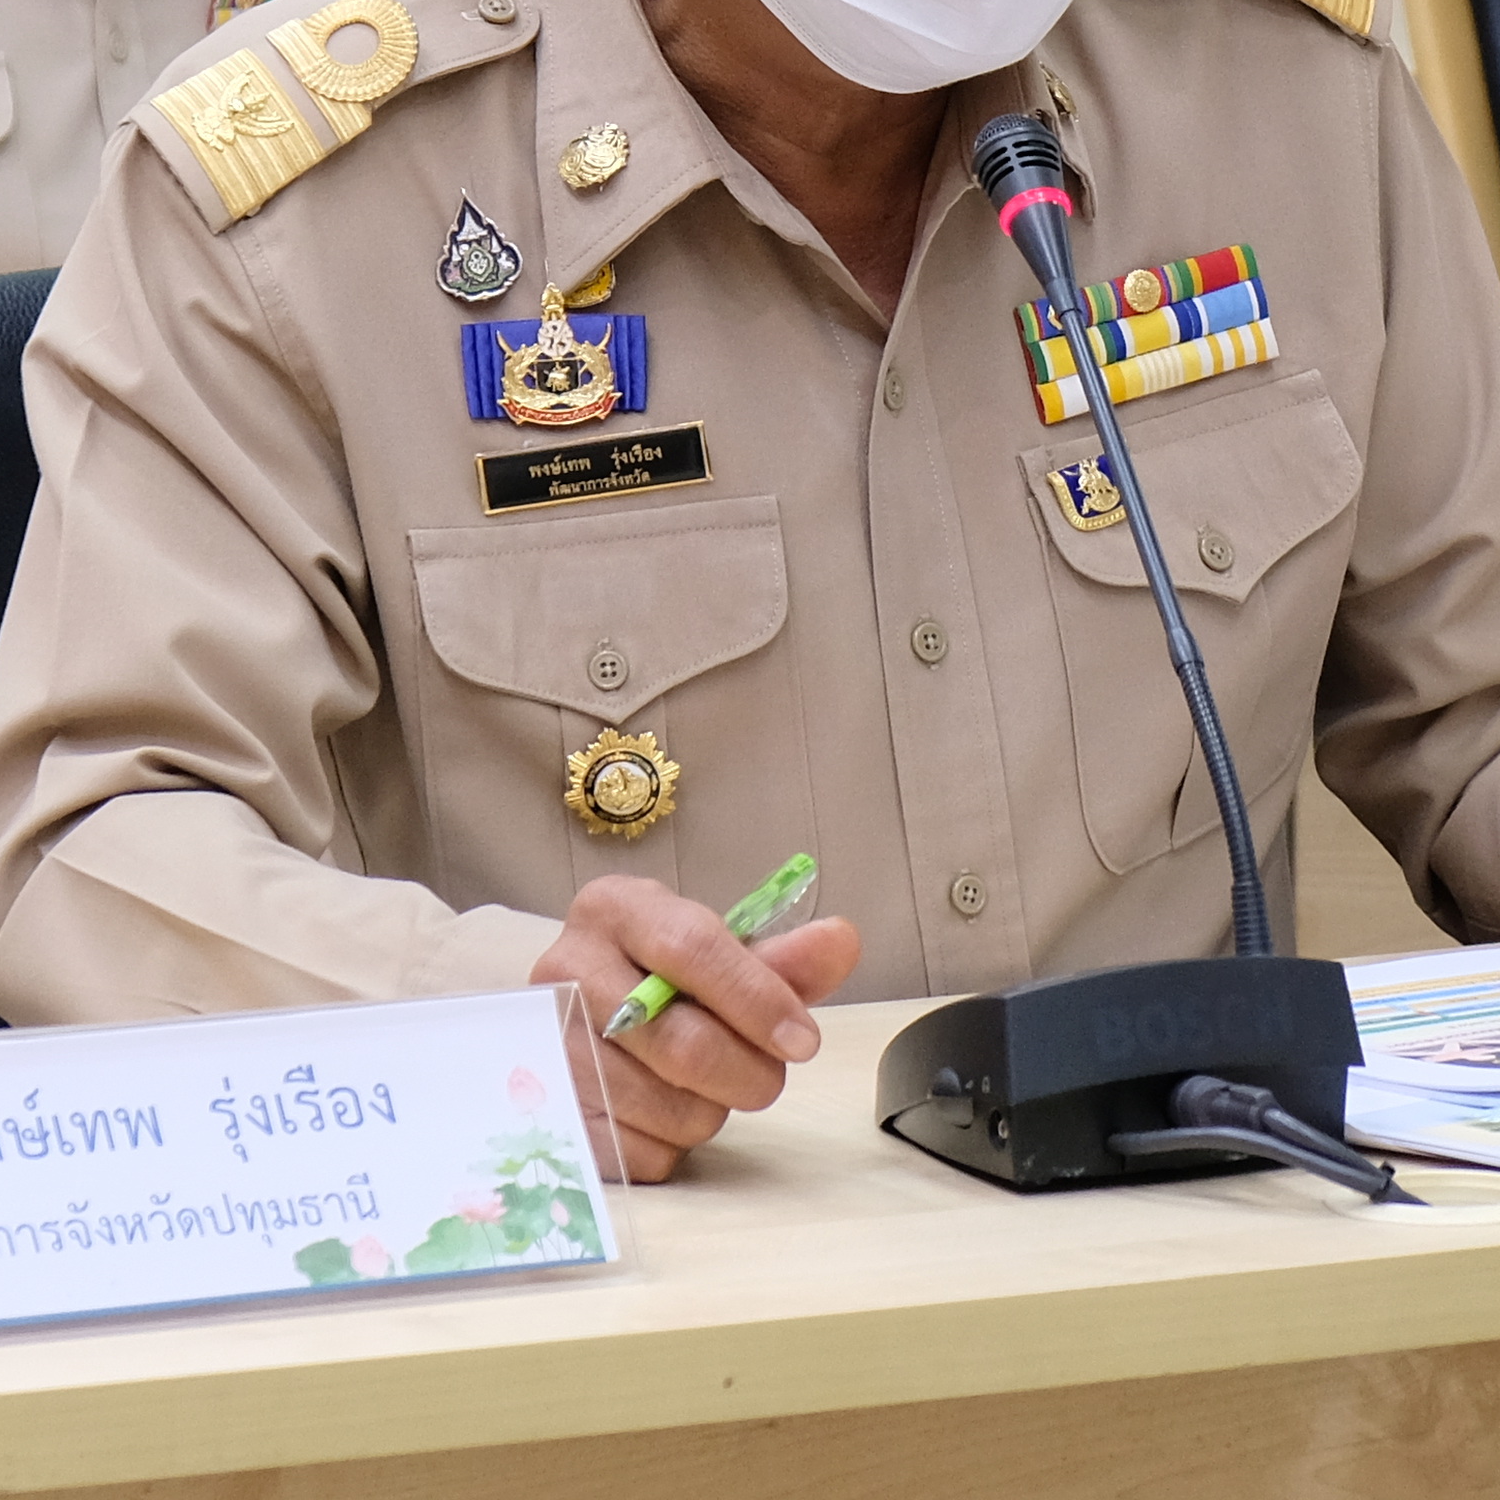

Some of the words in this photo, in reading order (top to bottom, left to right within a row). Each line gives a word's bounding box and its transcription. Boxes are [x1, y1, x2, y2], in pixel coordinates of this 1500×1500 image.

[527, 453, 592, 479] พงษ์เทพ
[610, 443, 663, 470] รุ่งเรือง
[548, 468, 652, 497] พัฒนาการจังหวัด
[208, 1063, 398, 1164] รุ่งเรือง
